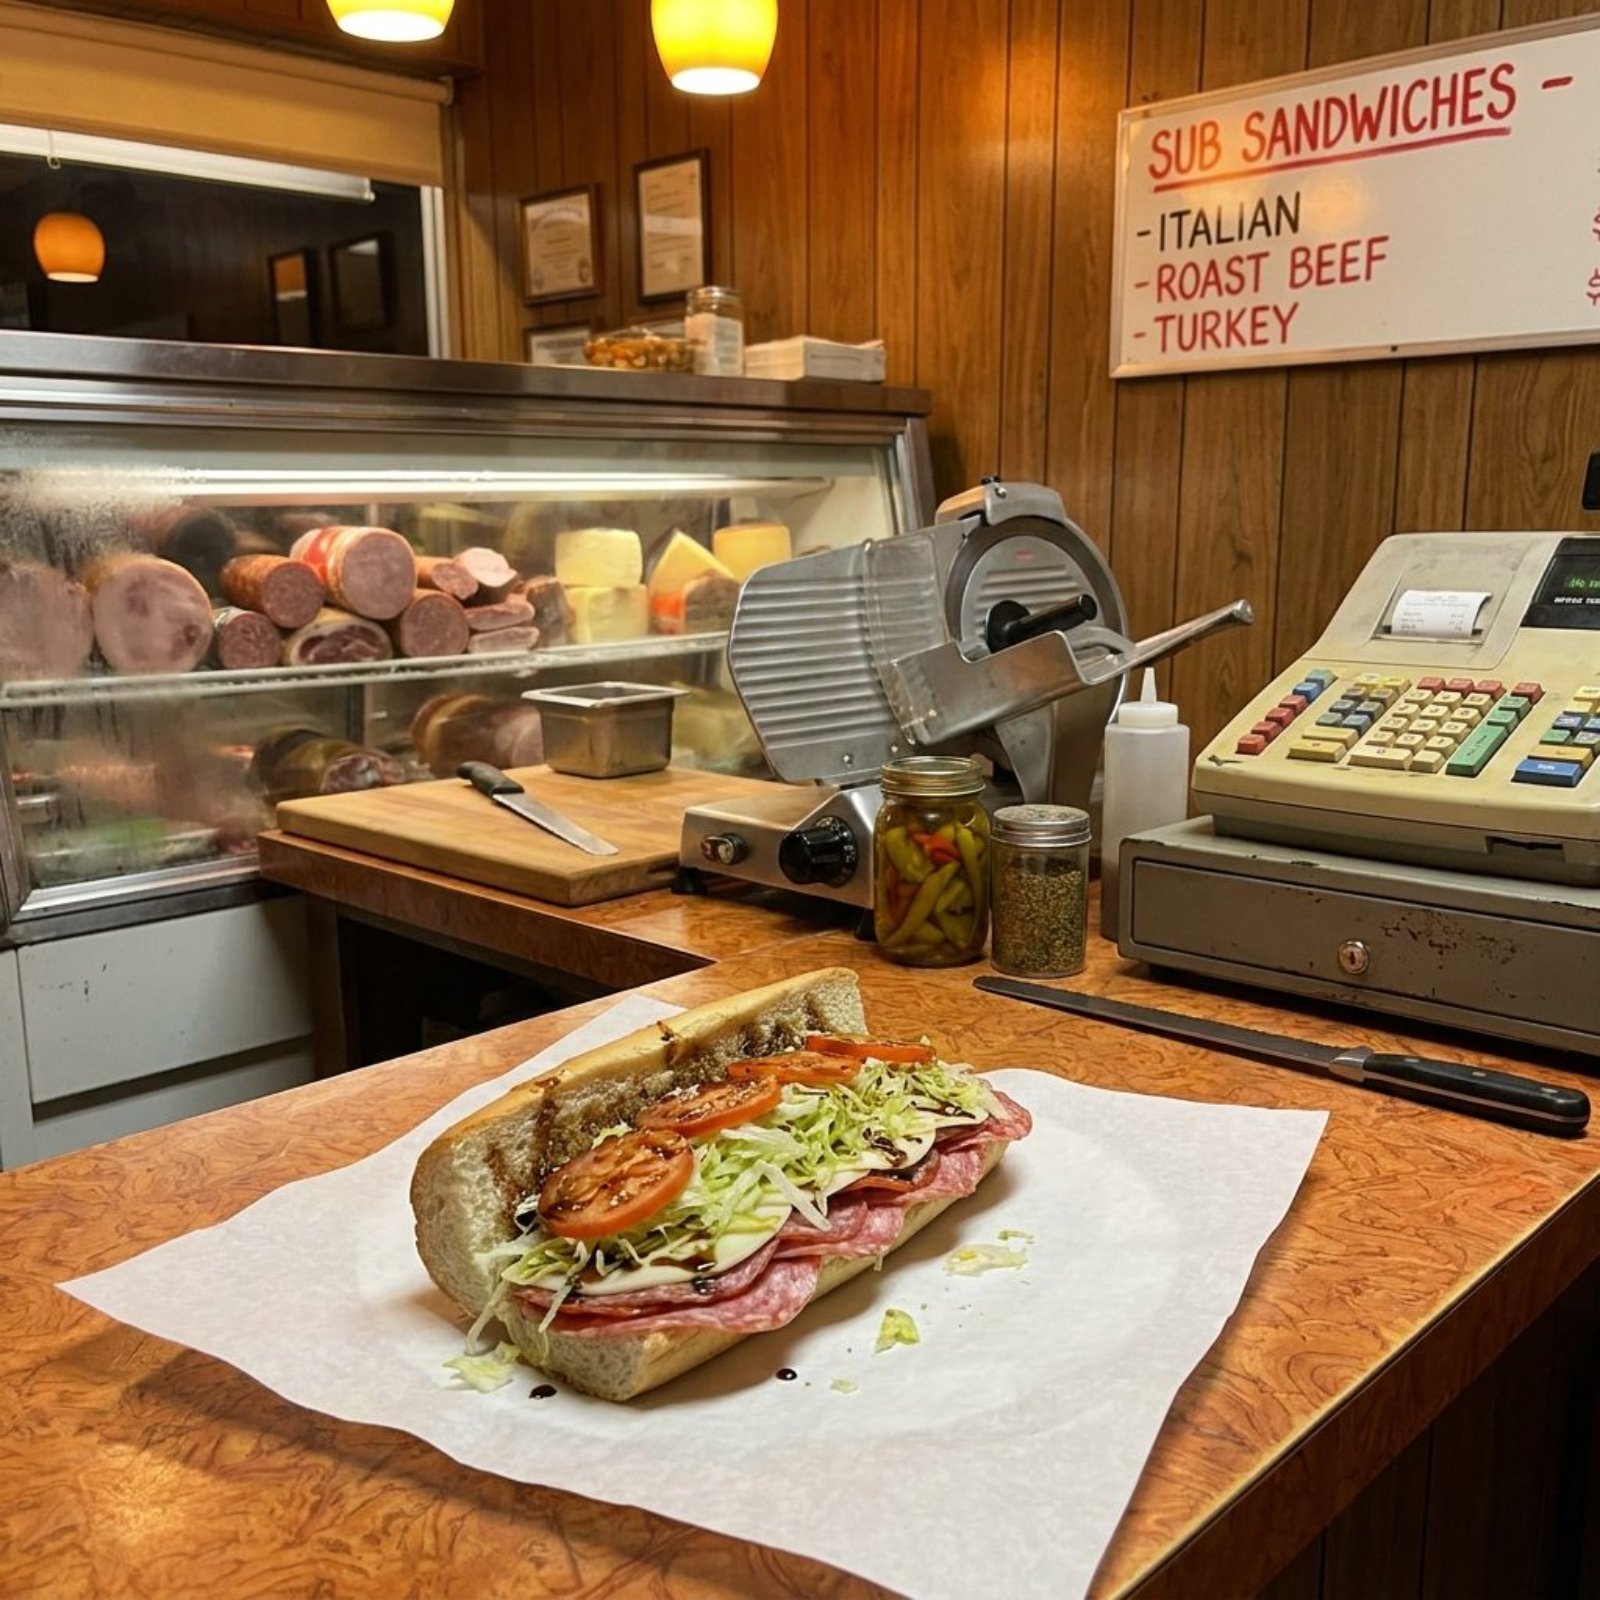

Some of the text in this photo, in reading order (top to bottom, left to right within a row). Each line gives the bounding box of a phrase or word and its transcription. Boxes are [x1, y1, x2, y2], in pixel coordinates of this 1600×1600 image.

[1148, 119, 1222, 180] SUB
[1242, 62, 1517, 164] SANDWICHES
[1288, 234, 1390, 290] BEEF
